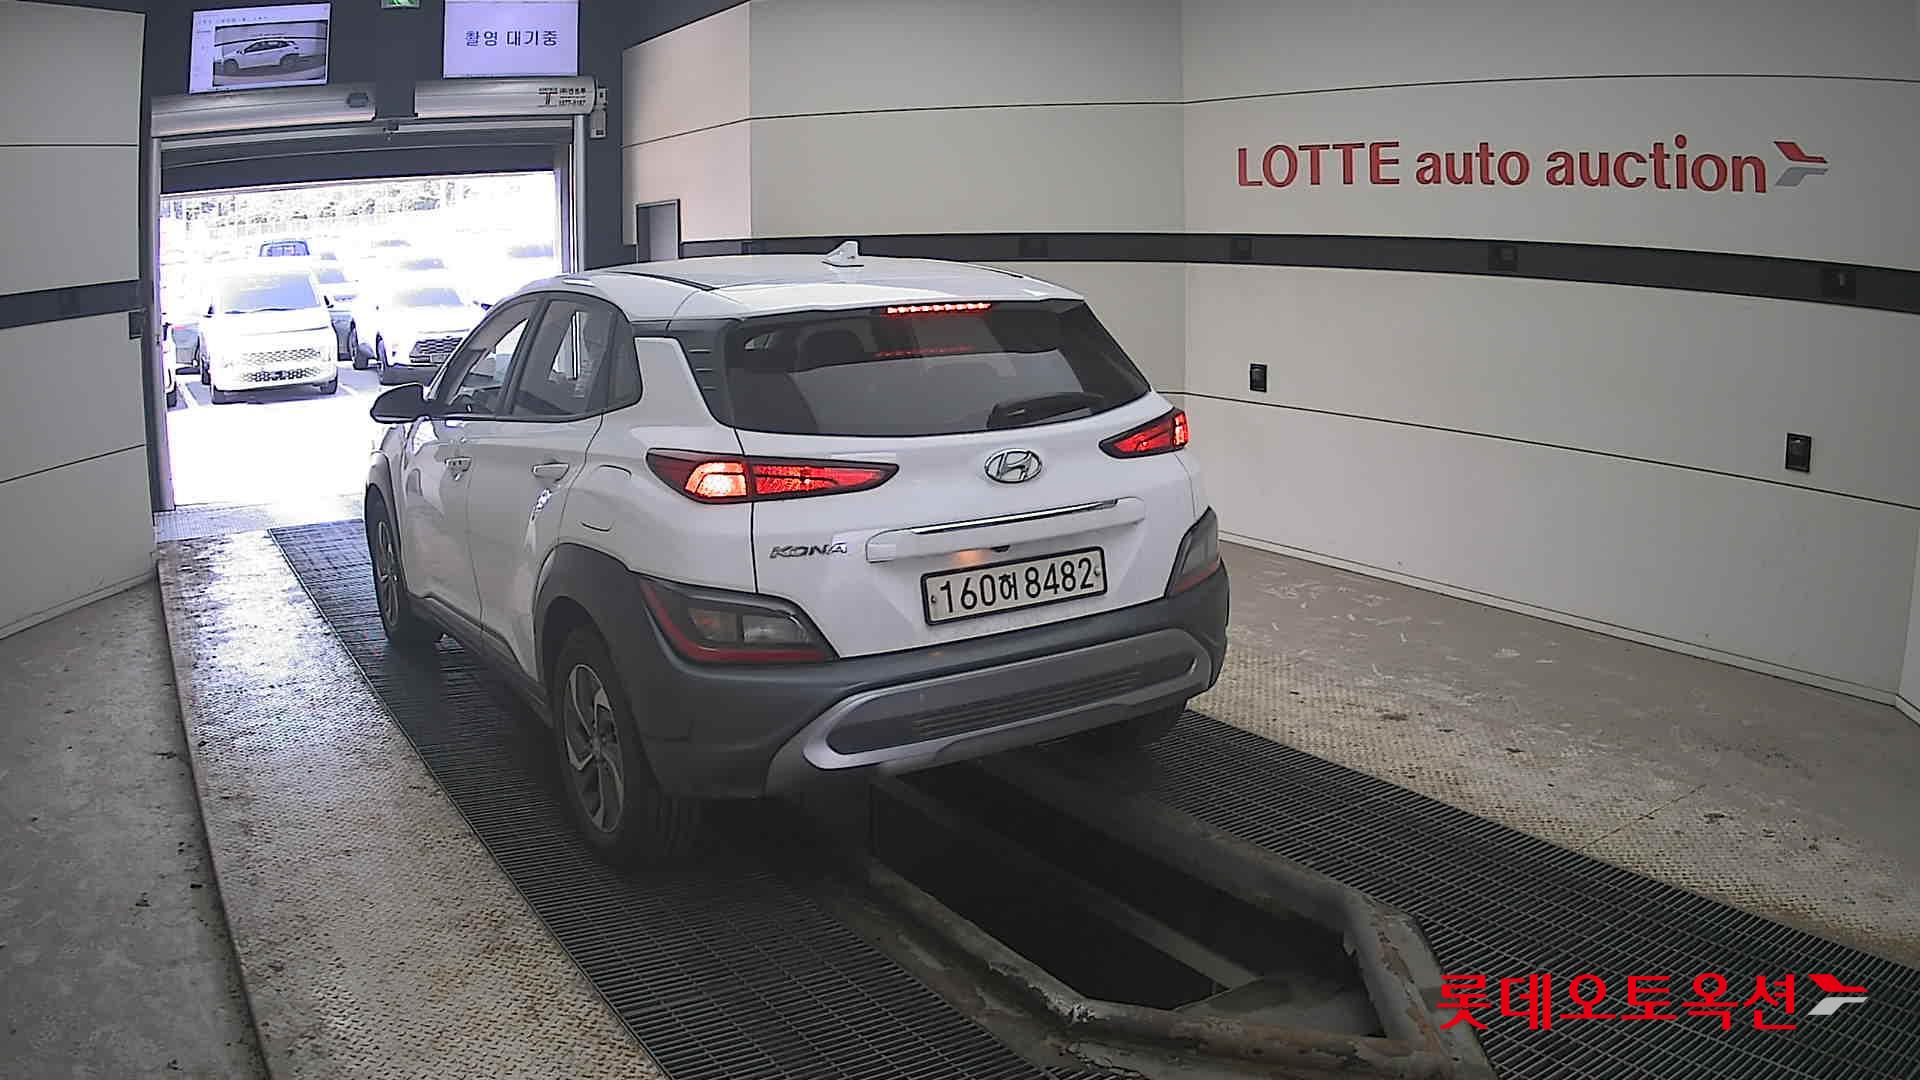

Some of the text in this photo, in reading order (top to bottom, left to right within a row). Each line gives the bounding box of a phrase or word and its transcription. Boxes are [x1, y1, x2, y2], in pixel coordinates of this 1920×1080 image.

[464, 29, 558, 47] 촬영 대기중
[1238, 134, 1768, 194] LOTTE auto auction
[770, 541, 848, 559] KONA
